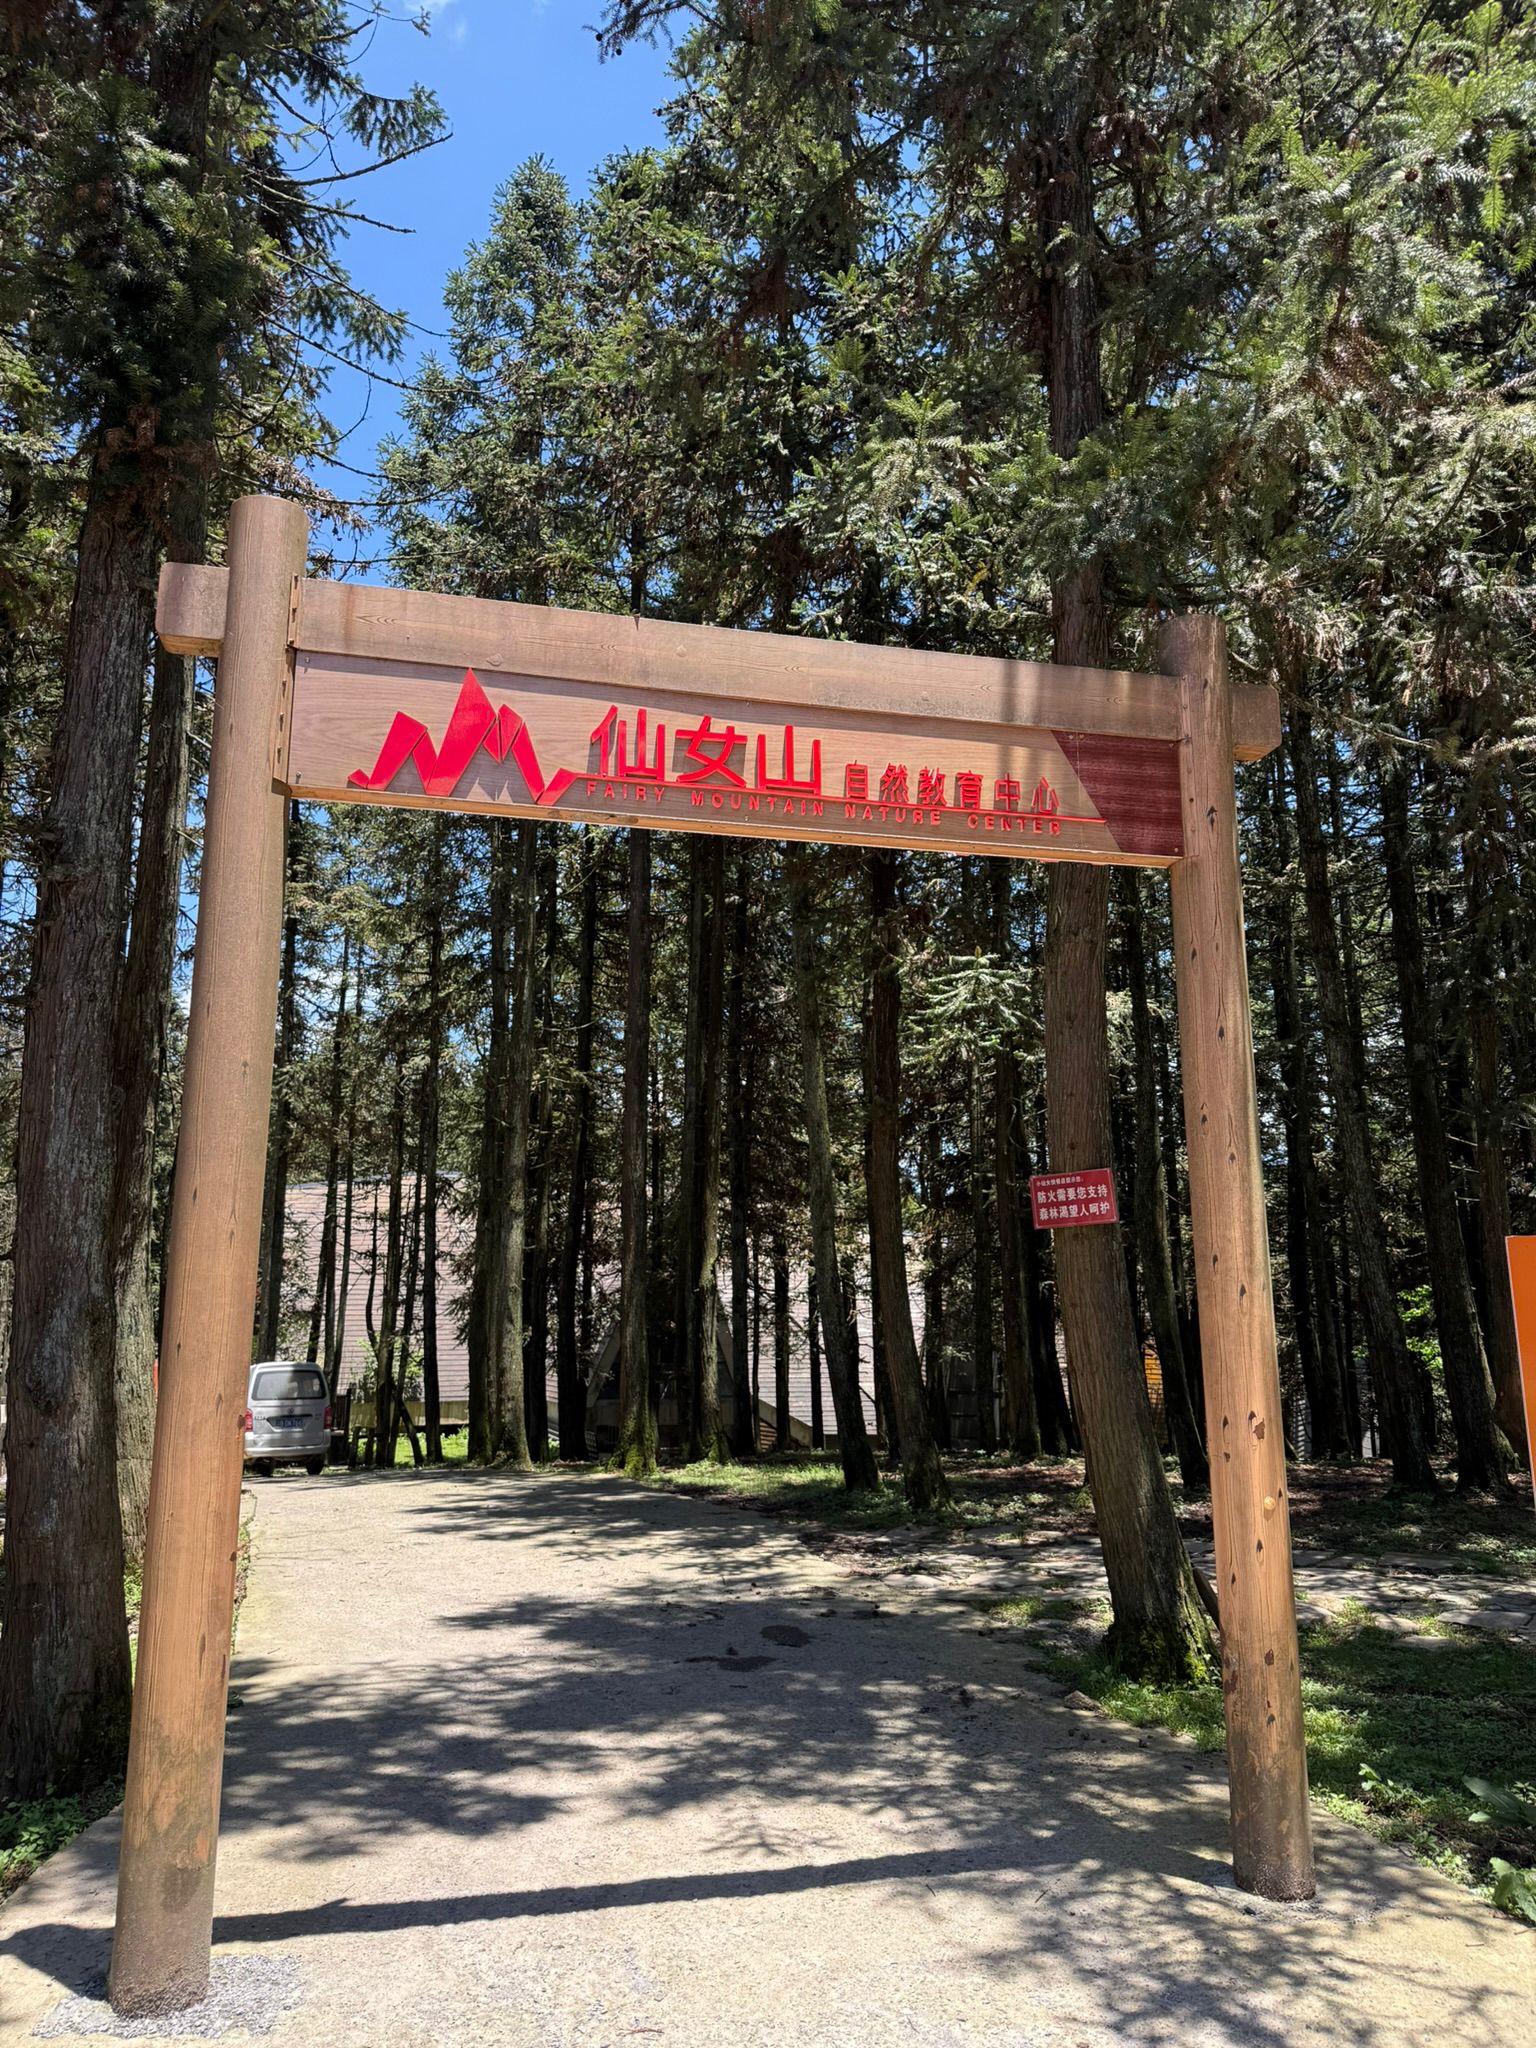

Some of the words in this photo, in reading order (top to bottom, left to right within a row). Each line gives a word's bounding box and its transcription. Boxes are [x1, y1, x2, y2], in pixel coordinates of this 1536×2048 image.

[590, 704, 822, 796] 仙女山
[845, 760, 1061, 813] 自然教育中心
[586, 781, 665, 803] FAIRY
[691, 790, 824, 816] MOUNTAIN
[845, 803, 942, 826] NATURE
[967, 813, 1061, 835] CENTER
[1037, 1184, 1108, 1203] 防火需要您支持
[1039, 1201, 1110, 1220] 森林渴望人呵护
